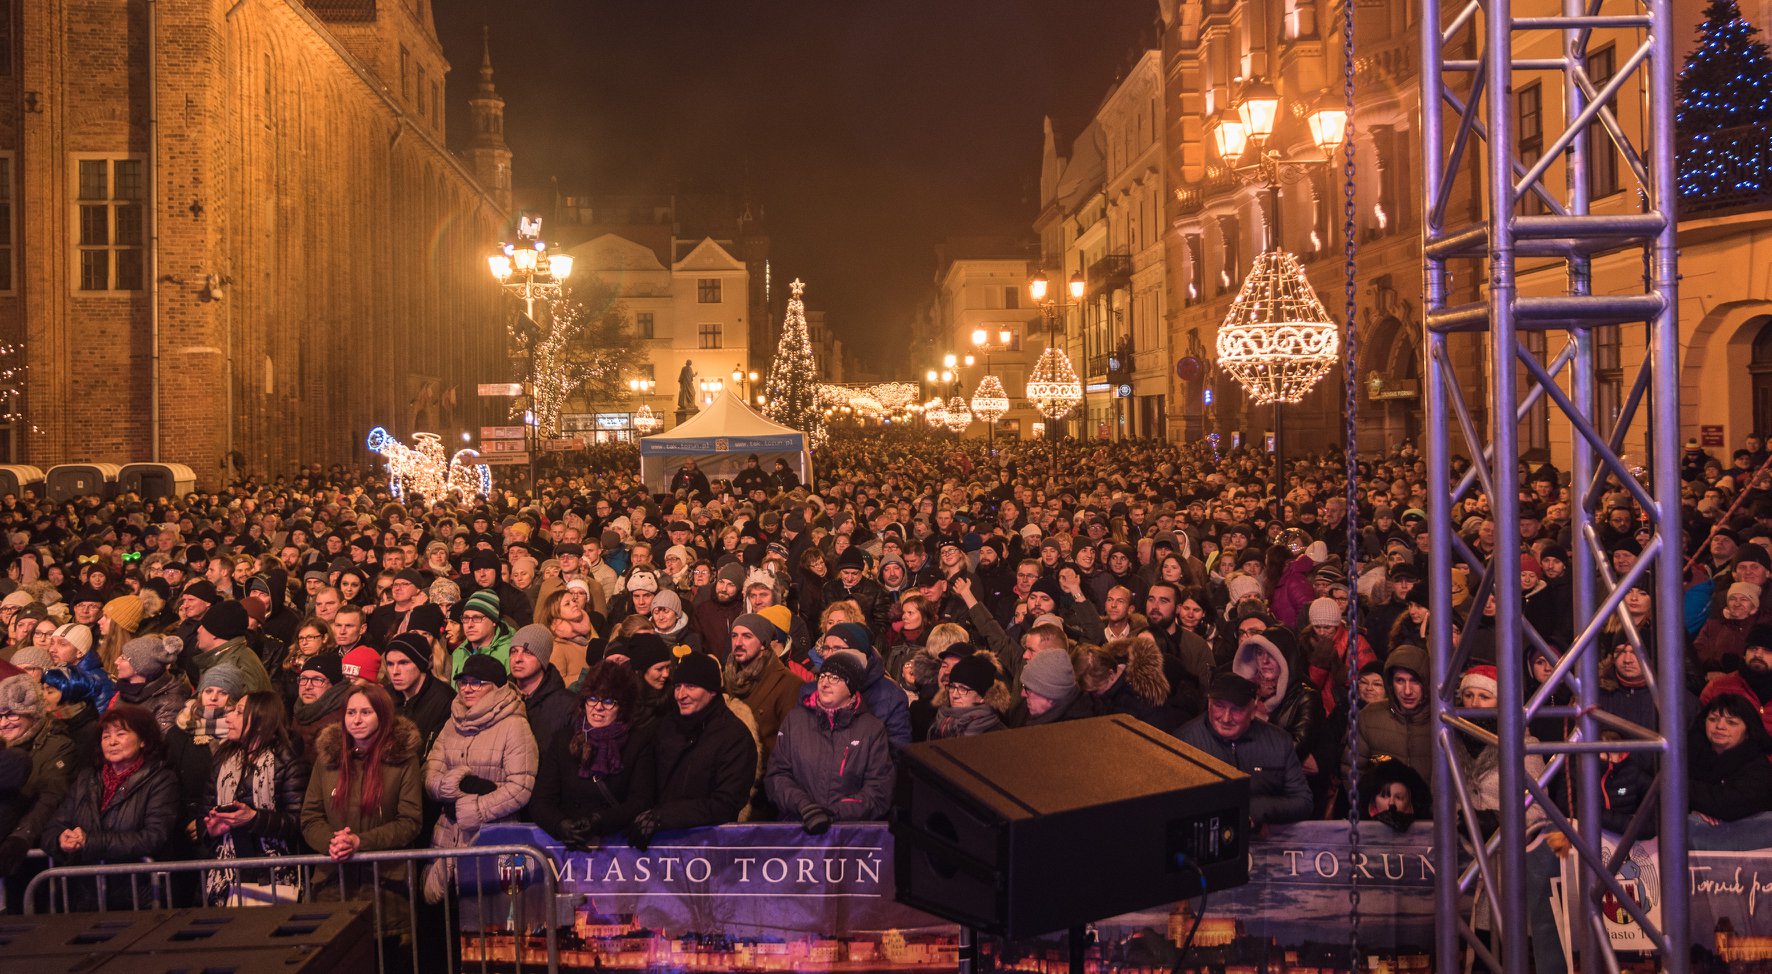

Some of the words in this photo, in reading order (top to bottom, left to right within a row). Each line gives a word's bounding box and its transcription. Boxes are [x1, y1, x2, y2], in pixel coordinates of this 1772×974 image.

[547, 857, 712, 883] MIASTO
[734, 852, 882, 883] TORUŃ
[1606, 927, 1635, 940] iasto
